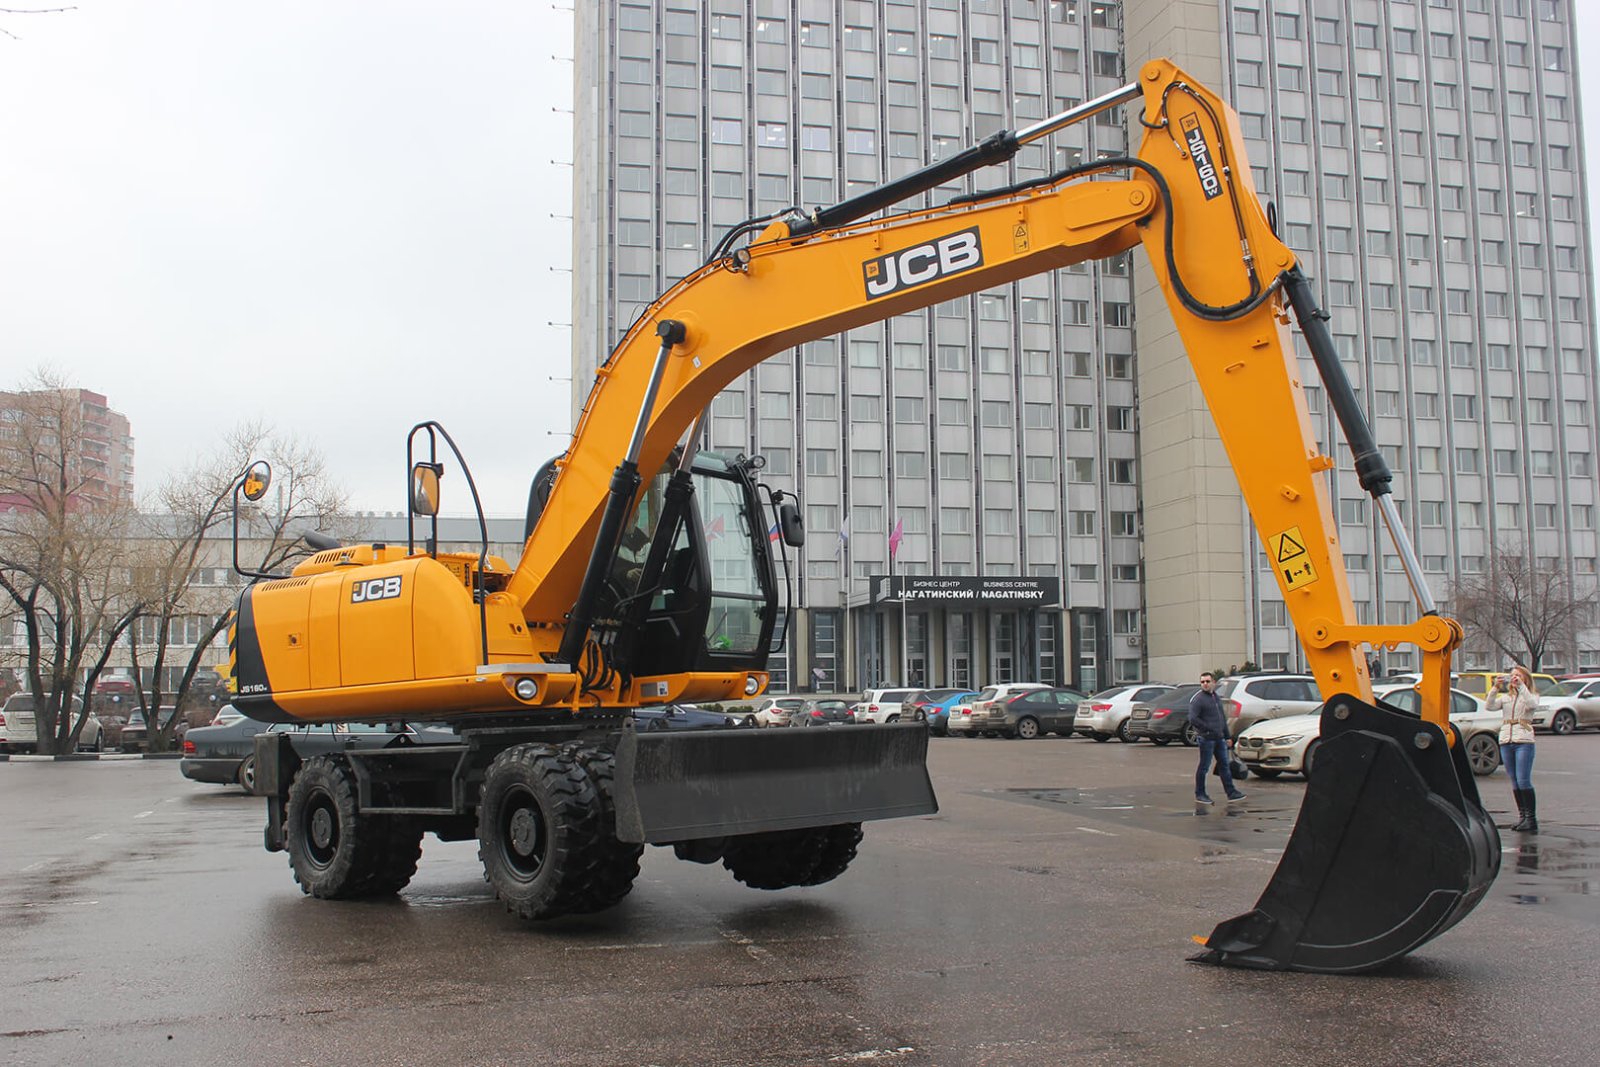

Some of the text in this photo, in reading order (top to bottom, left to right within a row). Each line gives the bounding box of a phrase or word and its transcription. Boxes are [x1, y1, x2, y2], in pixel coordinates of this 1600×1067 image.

[867, 231, 980, 296] JCB
[352, 576, 401, 602] JCB
[913, 580, 960, 588] БИЗНЕС ЦЕНТР
[898, 589, 974, 599] НАГАТИНСКИЙ
[981, 590, 1044, 599] NAGATINSKY
